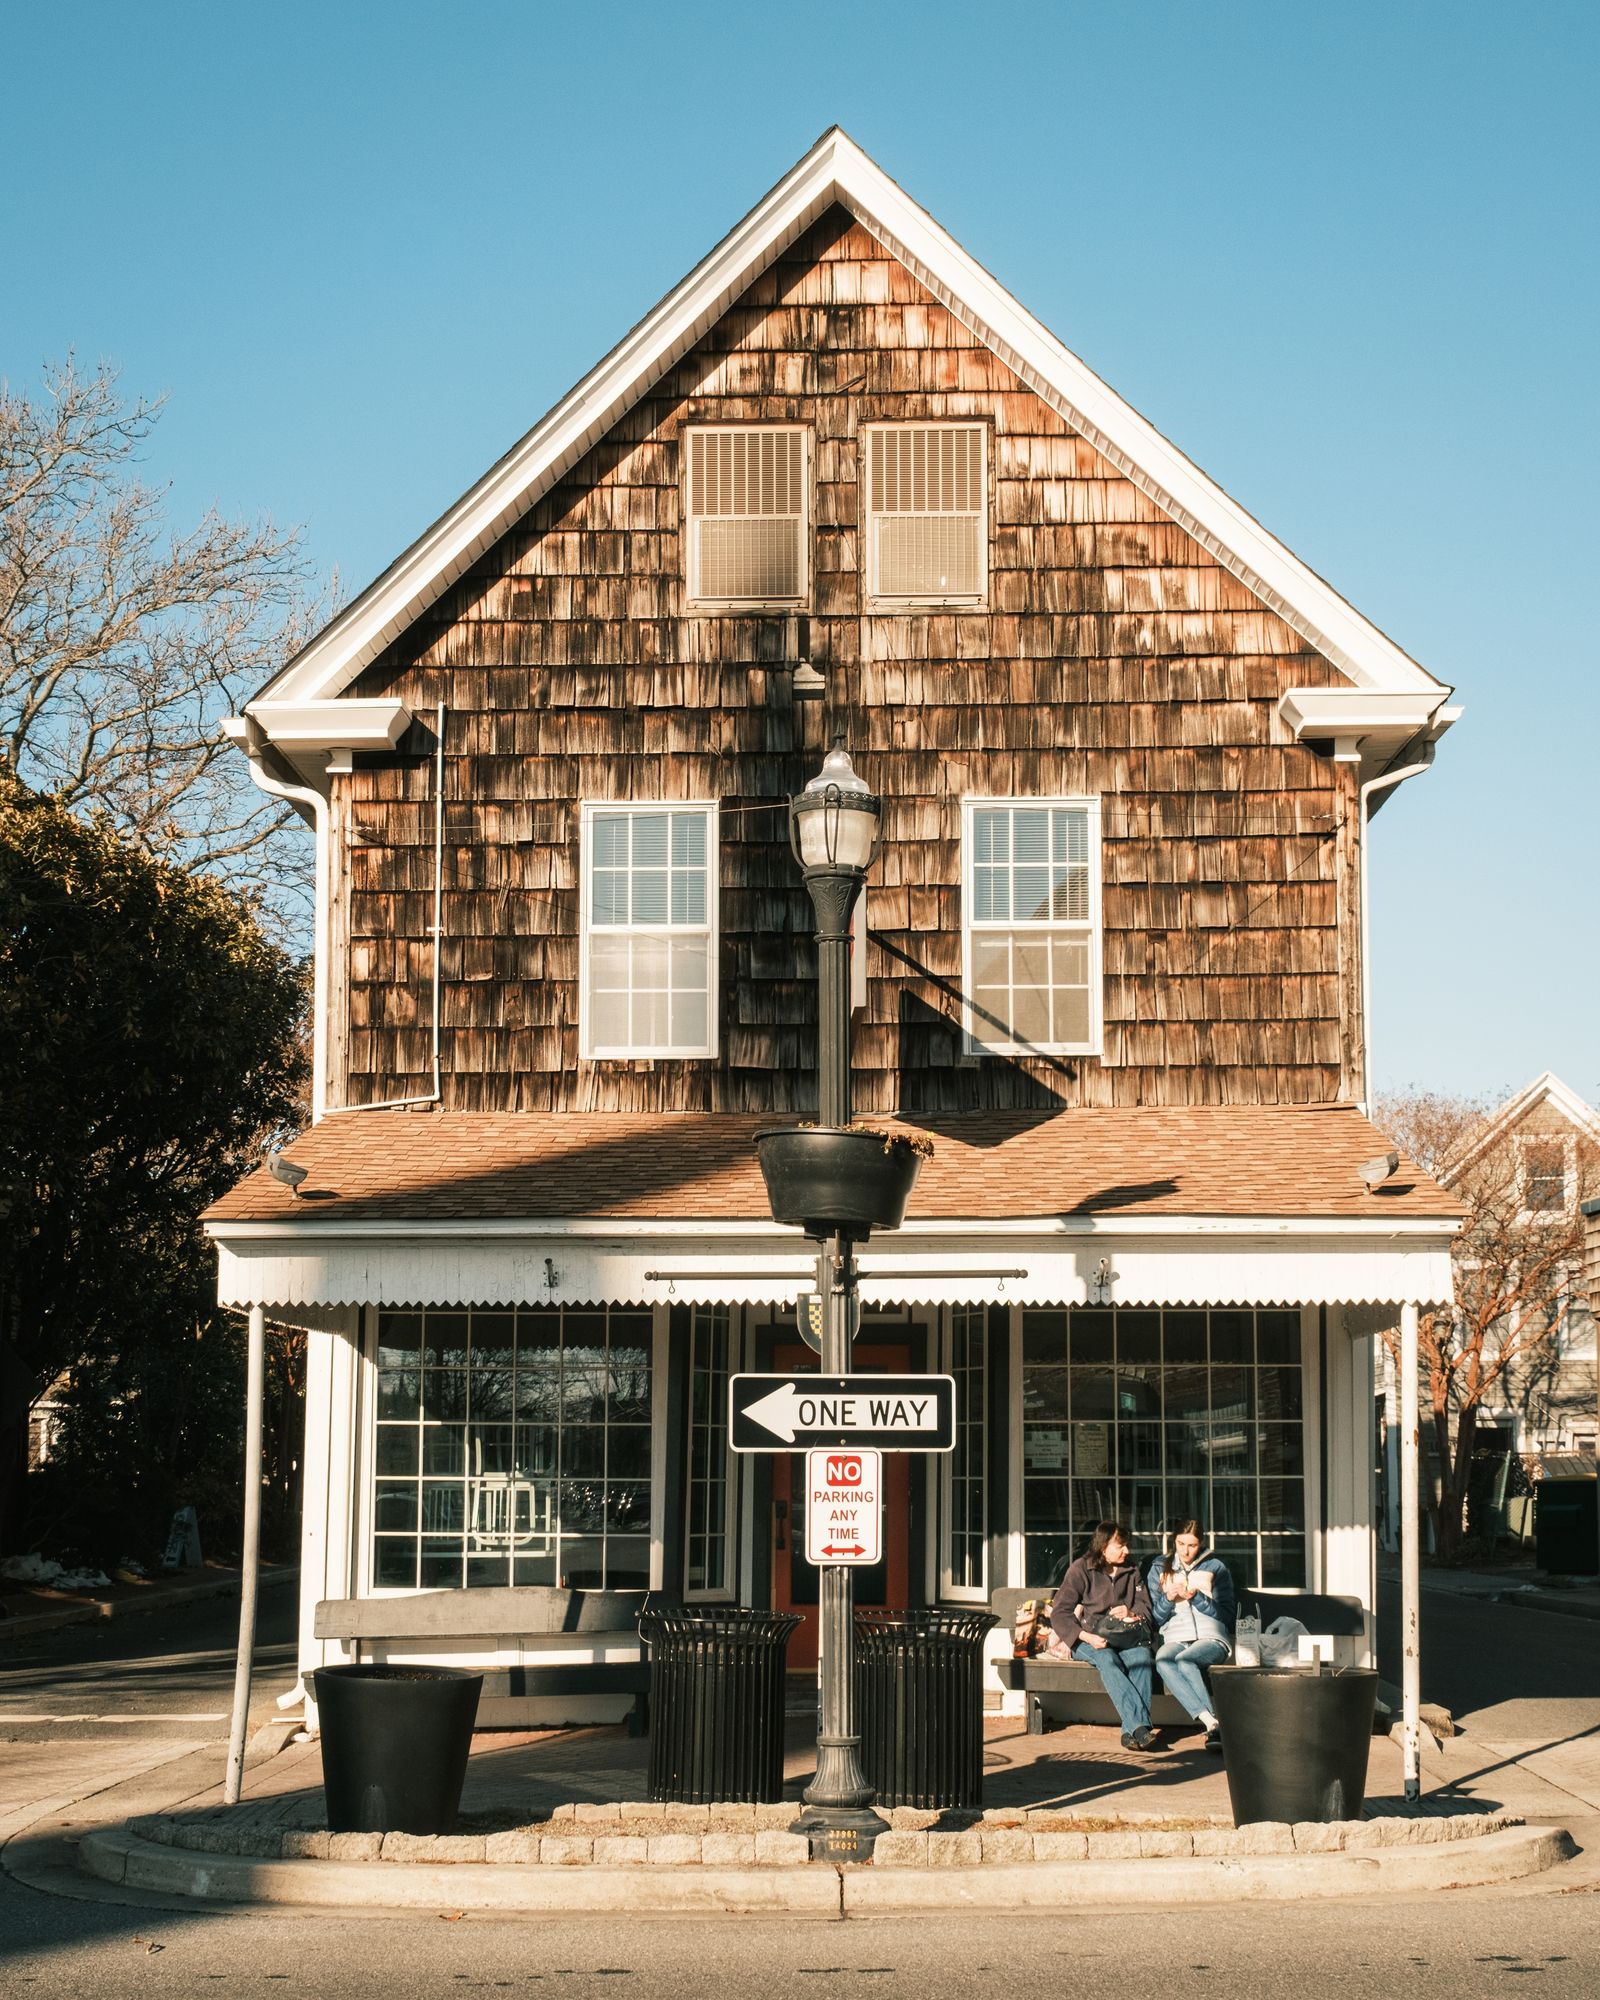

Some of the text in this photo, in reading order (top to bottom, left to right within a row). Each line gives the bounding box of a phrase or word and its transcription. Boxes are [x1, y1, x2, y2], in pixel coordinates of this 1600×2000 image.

[798, 1399, 929, 1427] ONE WAY
[826, 1461, 862, 1482] NO
[813, 1491, 874, 1503] PARKING
[829, 1509, 858, 1521] ANY
[827, 1527, 860, 1540] TIME
